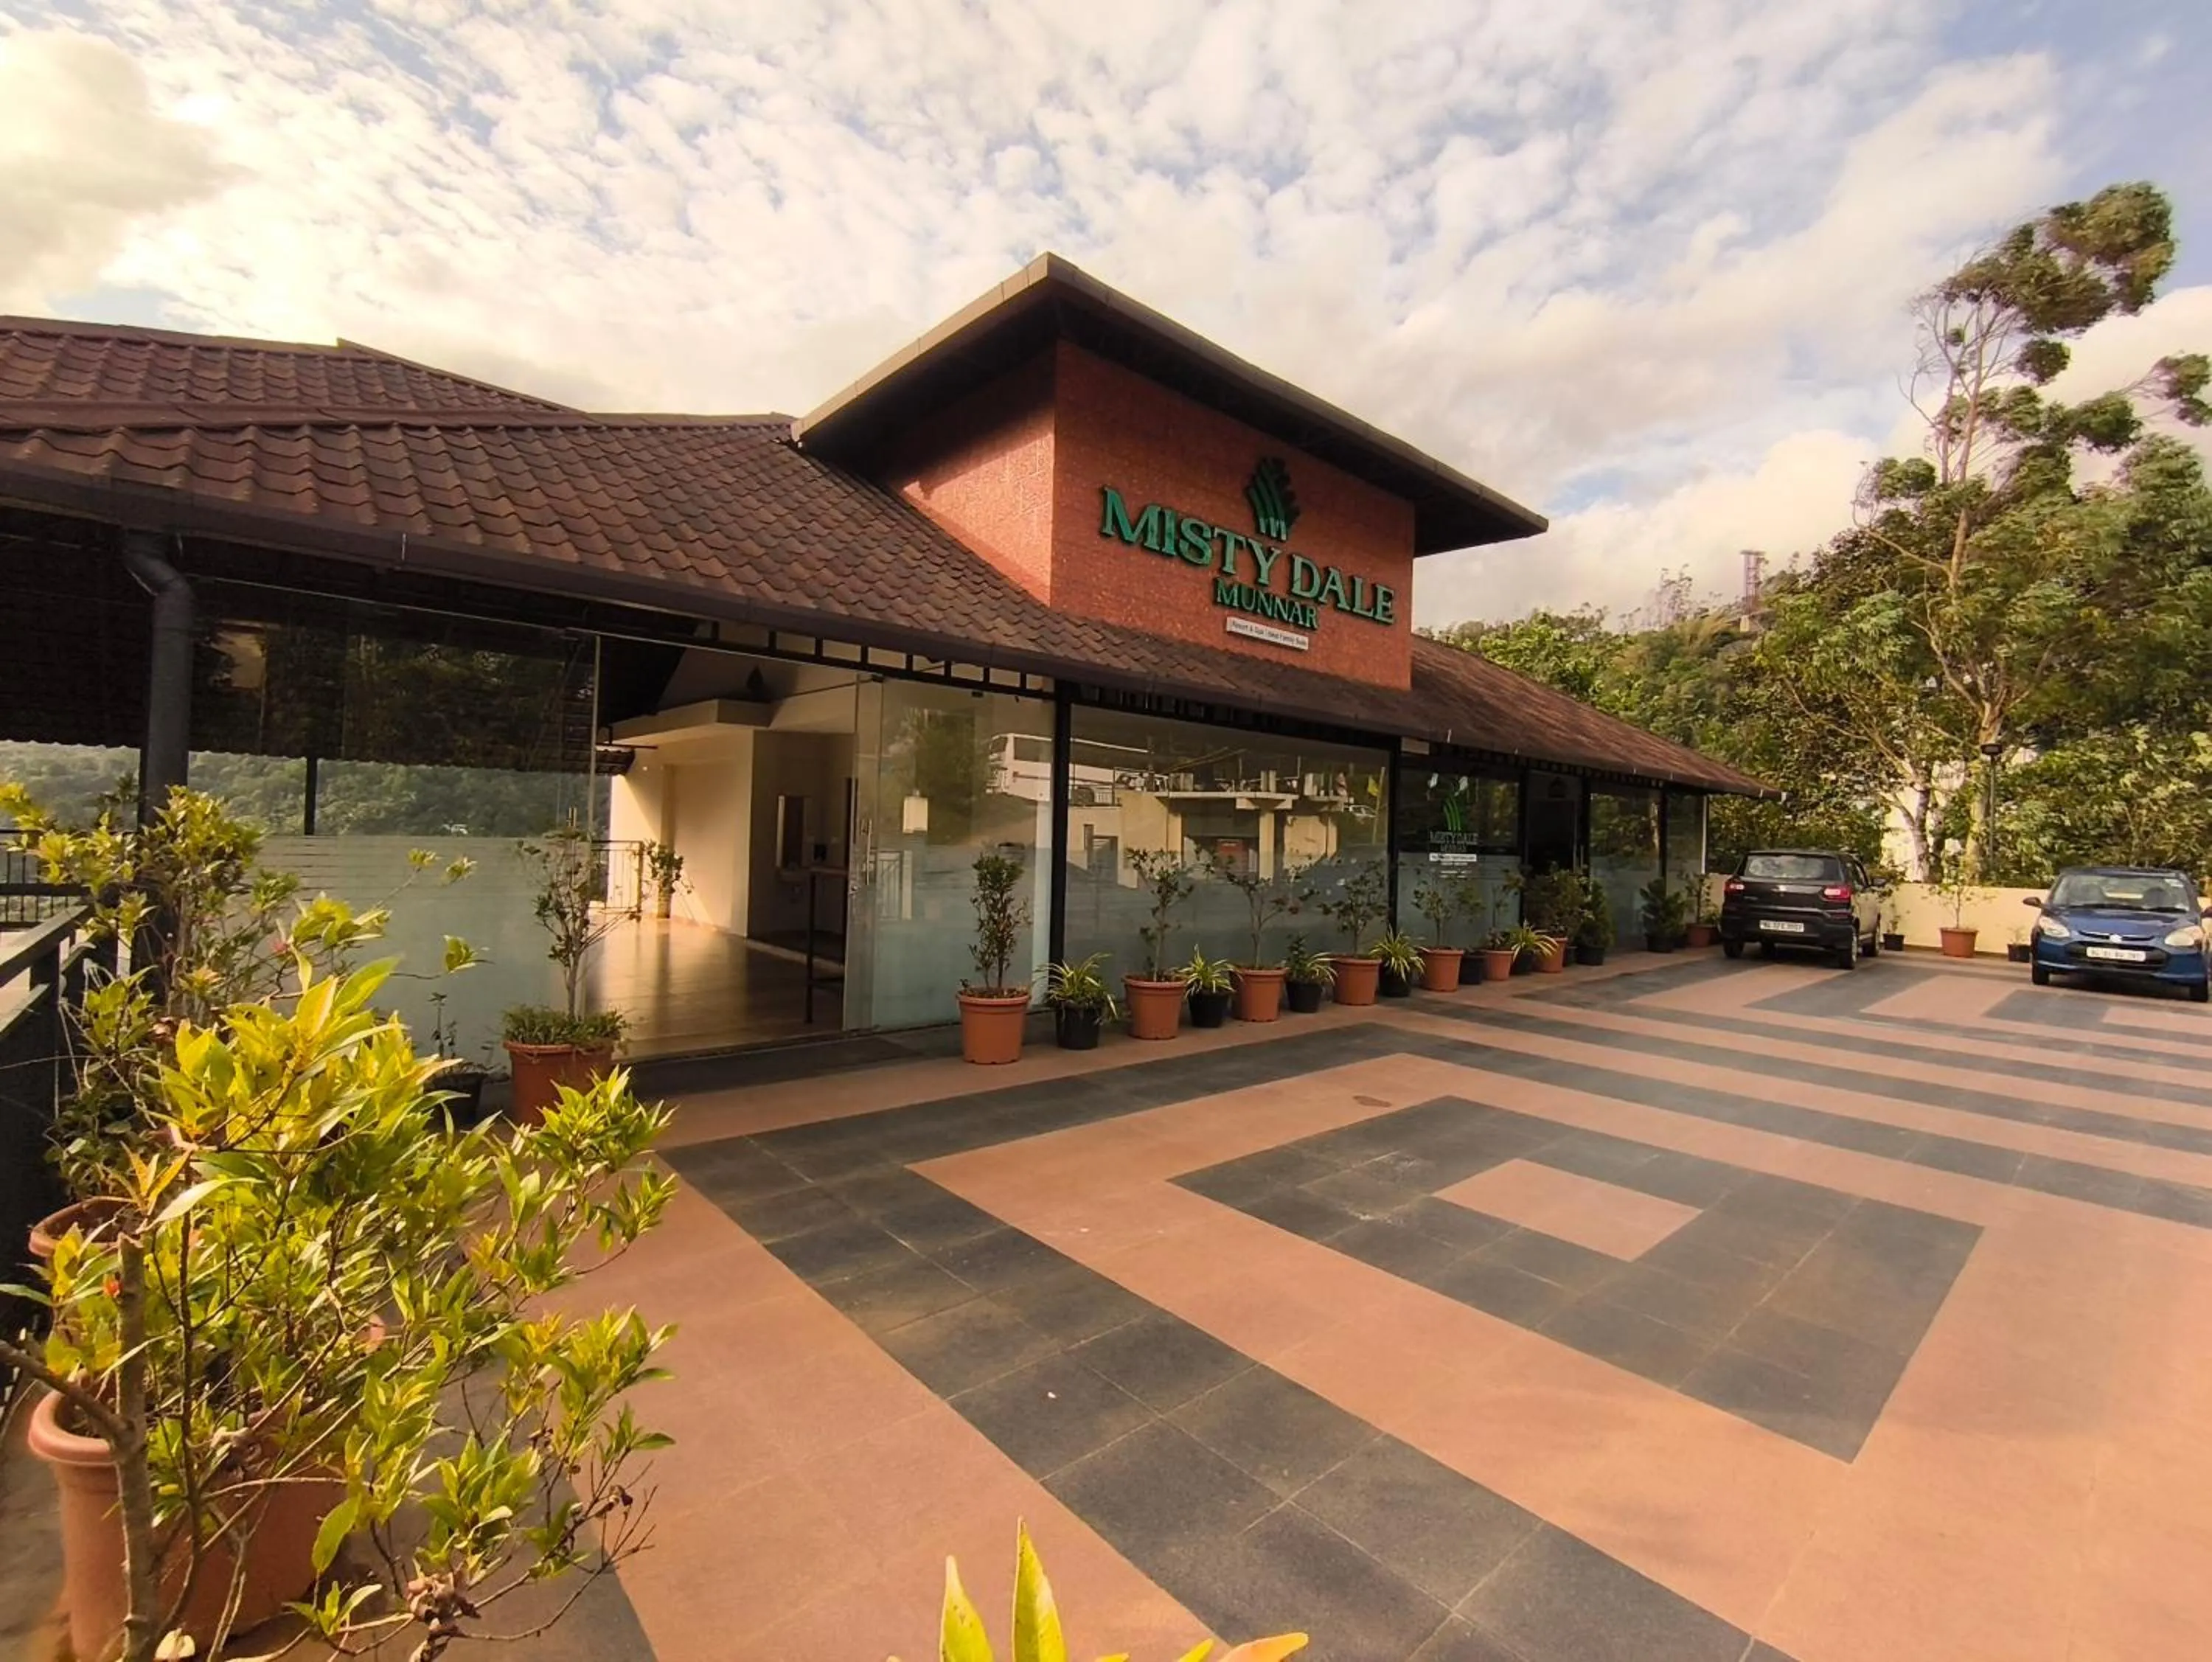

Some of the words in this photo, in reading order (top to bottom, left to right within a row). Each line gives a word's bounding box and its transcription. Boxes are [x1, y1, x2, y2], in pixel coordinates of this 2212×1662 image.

[1099, 486, 1282, 585] MISTY
[1290, 553, 1396, 625] DALE
[1214, 577, 1319, 630] MUNNAR
